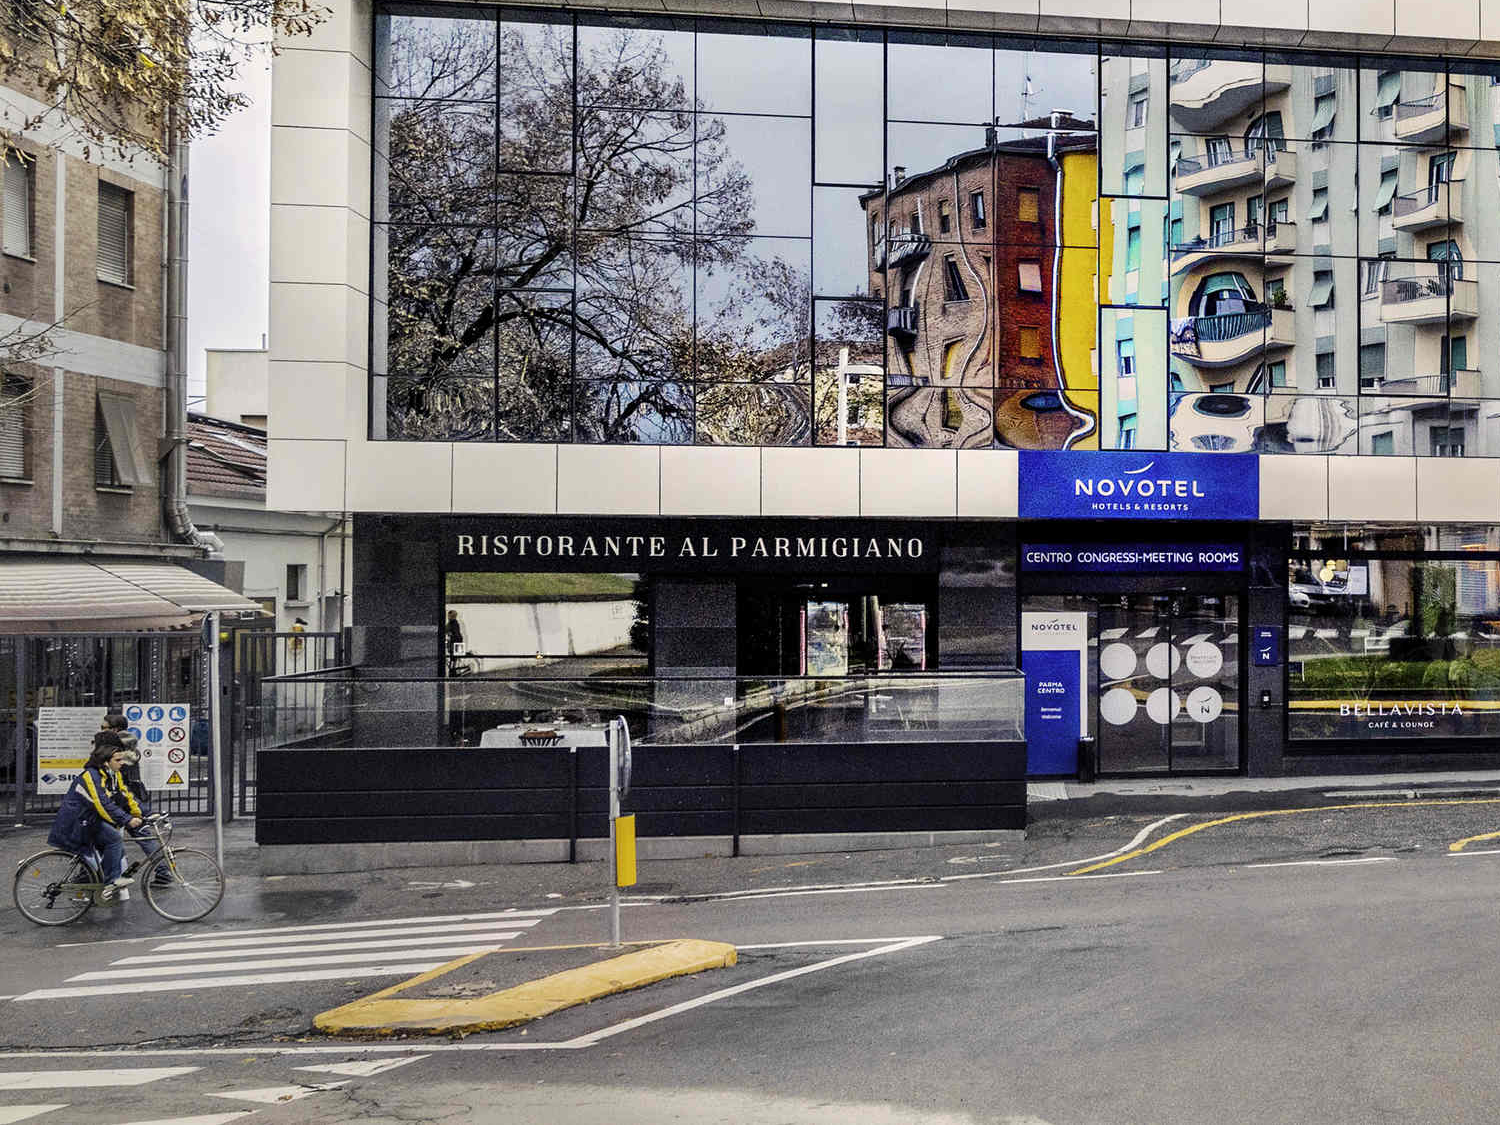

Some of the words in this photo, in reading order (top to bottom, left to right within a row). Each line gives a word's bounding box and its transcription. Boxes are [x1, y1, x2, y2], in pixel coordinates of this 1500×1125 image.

[1074, 478, 1206, 498] NOVOTEL
[1092, 503, 1132, 511] HOTELS
[1134, 503, 1141, 511] &
[1144, 503, 1189, 512] RESORTS
[456, 534, 666, 558] RISTORANTE
[678, 535, 719, 558] AL
[730, 536, 925, 559] PARMIGIANO
[1026, 552, 1073, 564] CENTRO
[1077, 552, 1194, 564] CONGRESSI-MEETING
[1198, 552, 1240, 564] ROOMS
[1031, 623, 1078, 632] NOVOTEL
[1262, 652, 1270, 660] N
[1340, 703, 1463, 716] BELLAVISTA
[1368, 720, 1389, 729] CAFÉ
[1391, 721, 1398, 729] &
[1400, 721, 1435, 729] LOUNGE
